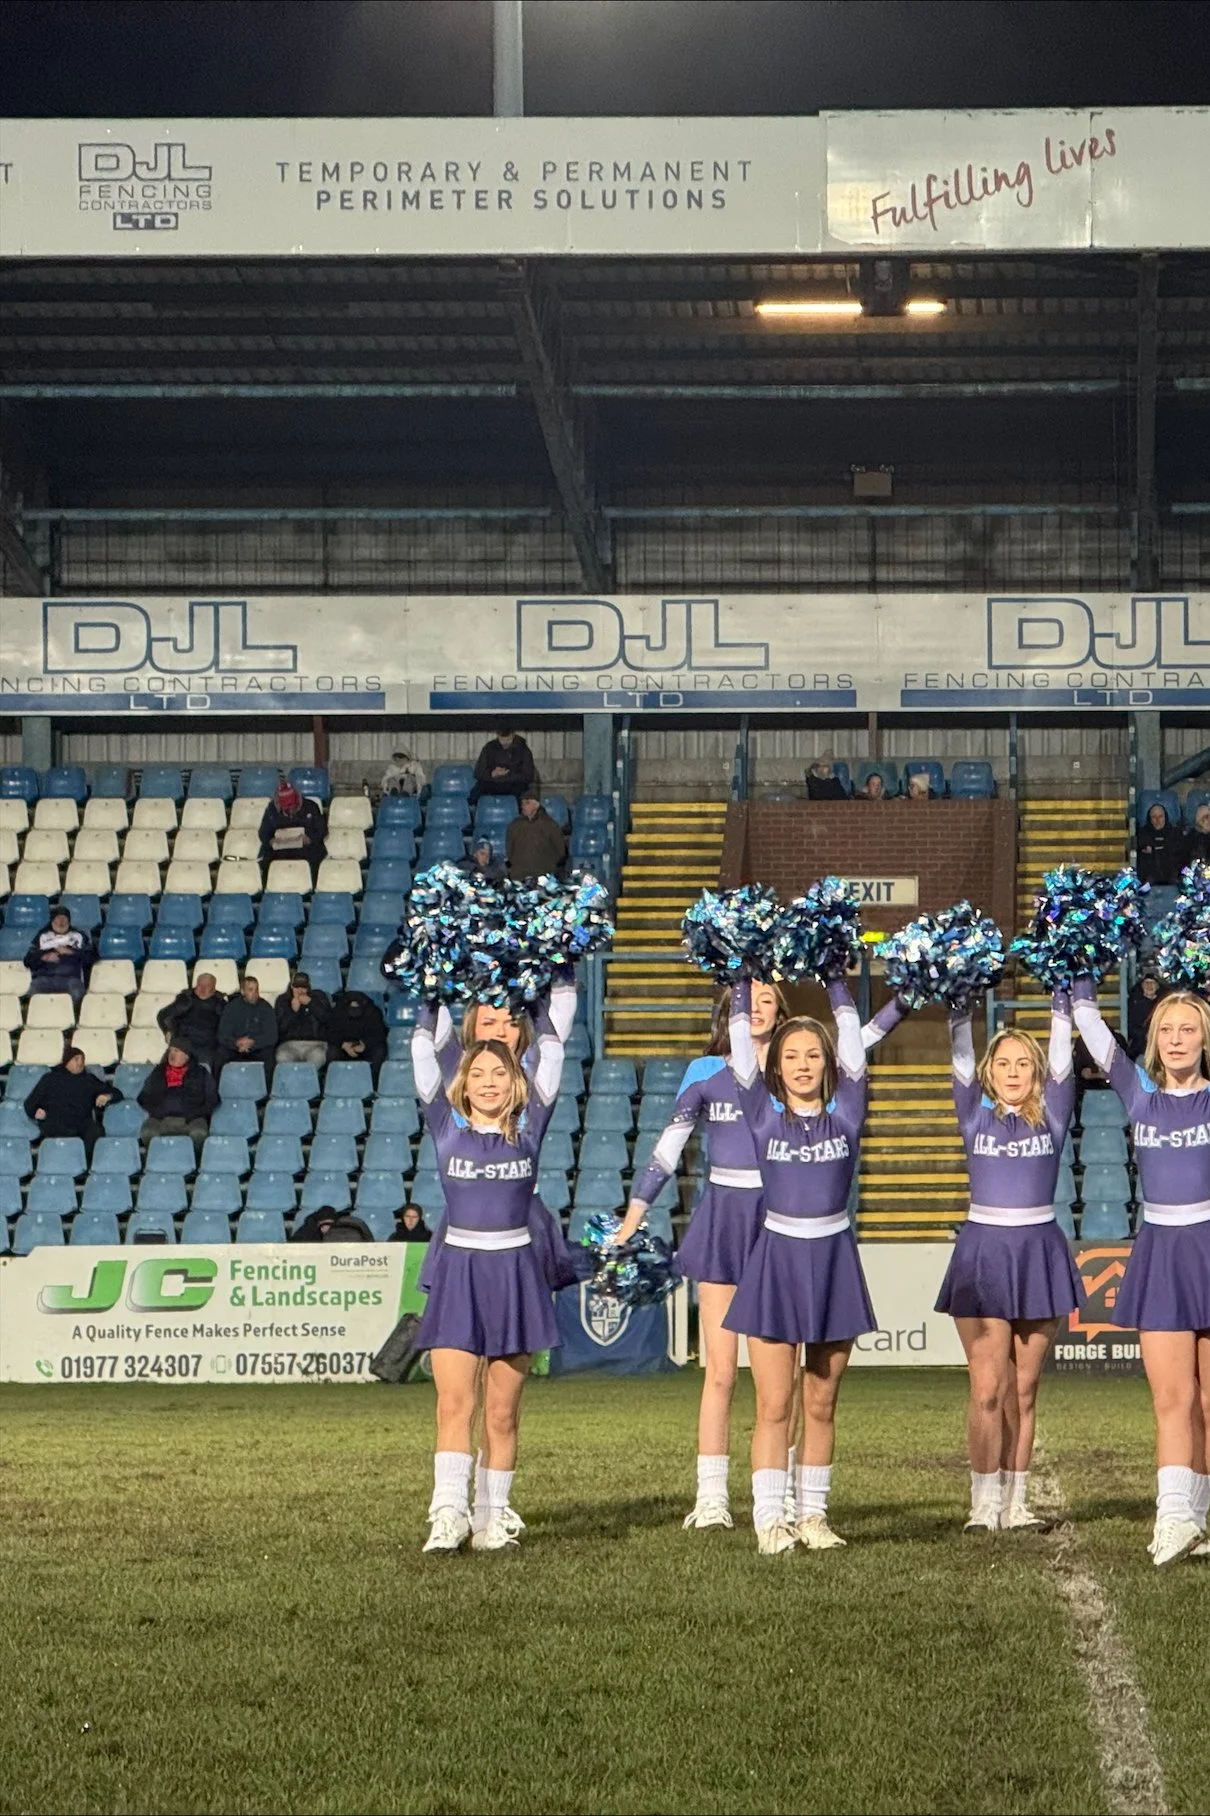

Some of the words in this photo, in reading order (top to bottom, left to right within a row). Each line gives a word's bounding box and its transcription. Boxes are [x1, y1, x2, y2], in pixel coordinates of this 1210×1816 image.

[79, 143, 212, 181] DJL
[276, 161, 481, 183] TEMPORARY
[503, 160, 519, 183] &
[542, 160, 751, 182] PERMANENT
[79, 184, 212, 199] FENCING
[871, 161, 1033, 234] Fulfilling
[1045, 128, 1116, 173] lives
[79, 200, 212, 211] CONTRACTORS
[316, 190, 512, 210] PERIMETER
[533, 189, 726, 209] SOLUTIONS
[115, 214, 176, 229] LTD
[43, 601, 297, 674] DJL
[516, 600, 769, 672] DJL
[0, 677, 106, 692] NCING
[123, 676, 382, 692] CONTRACTORS
[433, 675, 580, 690] FENCING
[596, 674, 853, 689] CONTRACTORS
[904, 672, 1049, 688] FENCING
[130, 694, 210, 709] LTD
[604, 692, 684, 707] LTD
[1073, 690, 1153, 705] LTD
[850, 881, 895, 901] EXIT
[767, 1135, 849, 1163] ALL-STARS
[973, 1133, 1054, 1157] ALL-STARS
[448, 1156, 532, 1180] ALL-STARS
[330, 1255, 388, 1267] DuraPost
[229, 1260, 316, 1285] Fencing
[37, 1258, 218, 1314] JC
[229, 1287, 245, 1306] &
[252, 1286, 382, 1311] Landscapes
[72, 1326, 82, 1340] A
[86, 1325, 141, 1342] Quality
[146, 1325, 188, 1339] Fence
[193, 1324, 239, 1339] Makes
[243, 1323, 298, 1338] Perfect
[301, 1323, 346, 1337] Sense
[1055, 1344, 1107, 1360] FORGE
[1112, 1344, 1140, 1360] BUI
[61, 1355, 118, 1378] 01977
[125, 1355, 202, 1378] 324307
[236, 1353, 297, 1376] 07557
